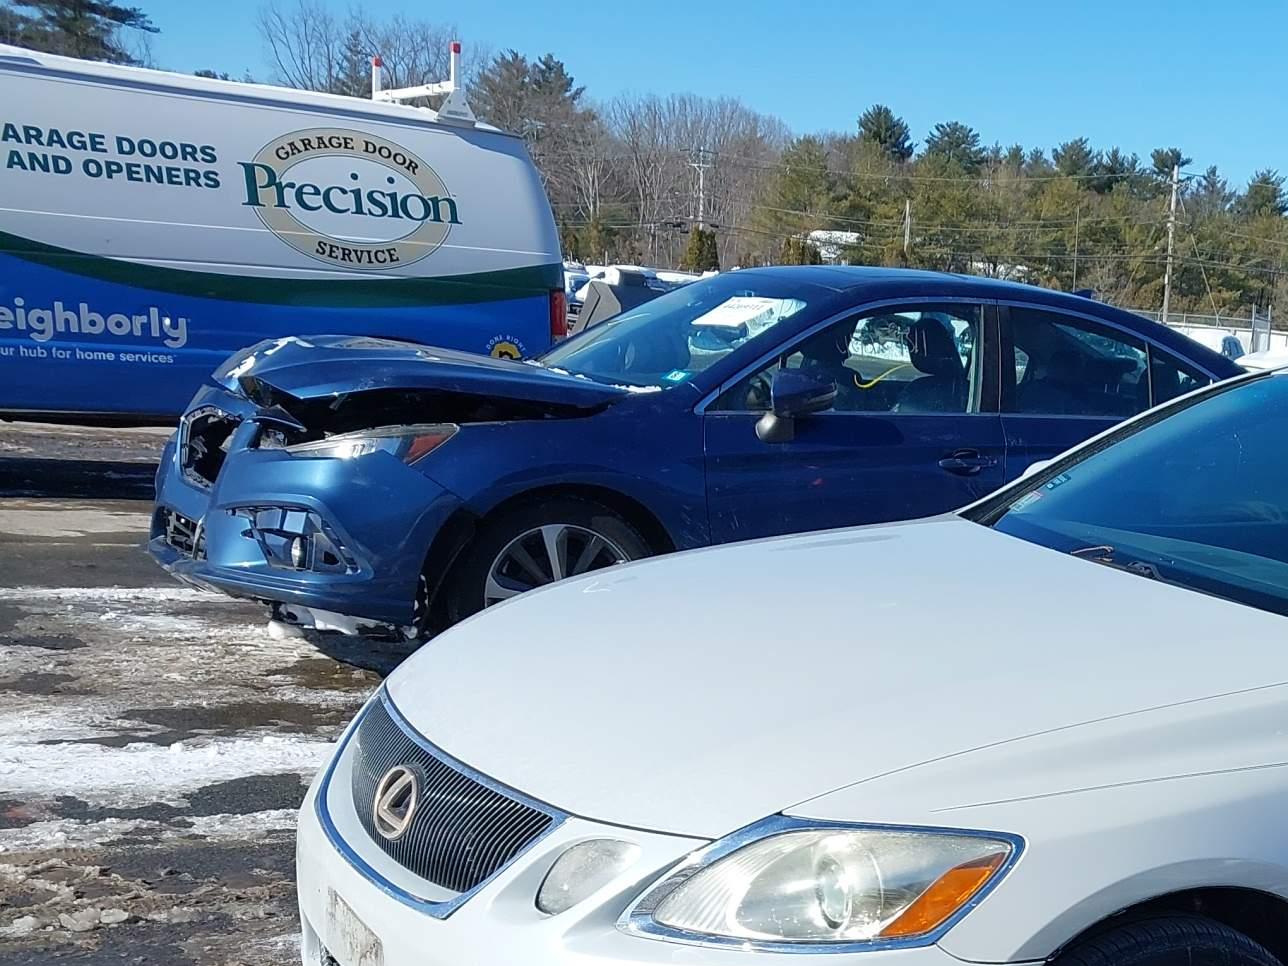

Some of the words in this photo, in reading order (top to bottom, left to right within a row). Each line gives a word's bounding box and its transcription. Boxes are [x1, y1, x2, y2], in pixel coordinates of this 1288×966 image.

[1, 123, 108, 153] ARAGE
[115, 136, 218, 164] DOORS
[275, 136, 355, 161] GARAGE
[362, 139, 419, 175] DOOR
[6, 150, 73, 175] AND
[82, 158, 221, 189] OPENERS
[237, 161, 463, 225] Precision
[315, 240, 400, 265] SERVICE
[19, 345, 48, 358] hub
[52, 346, 71, 359] for
[76, 348, 115, 361] home
[119, 351, 174, 364] services
